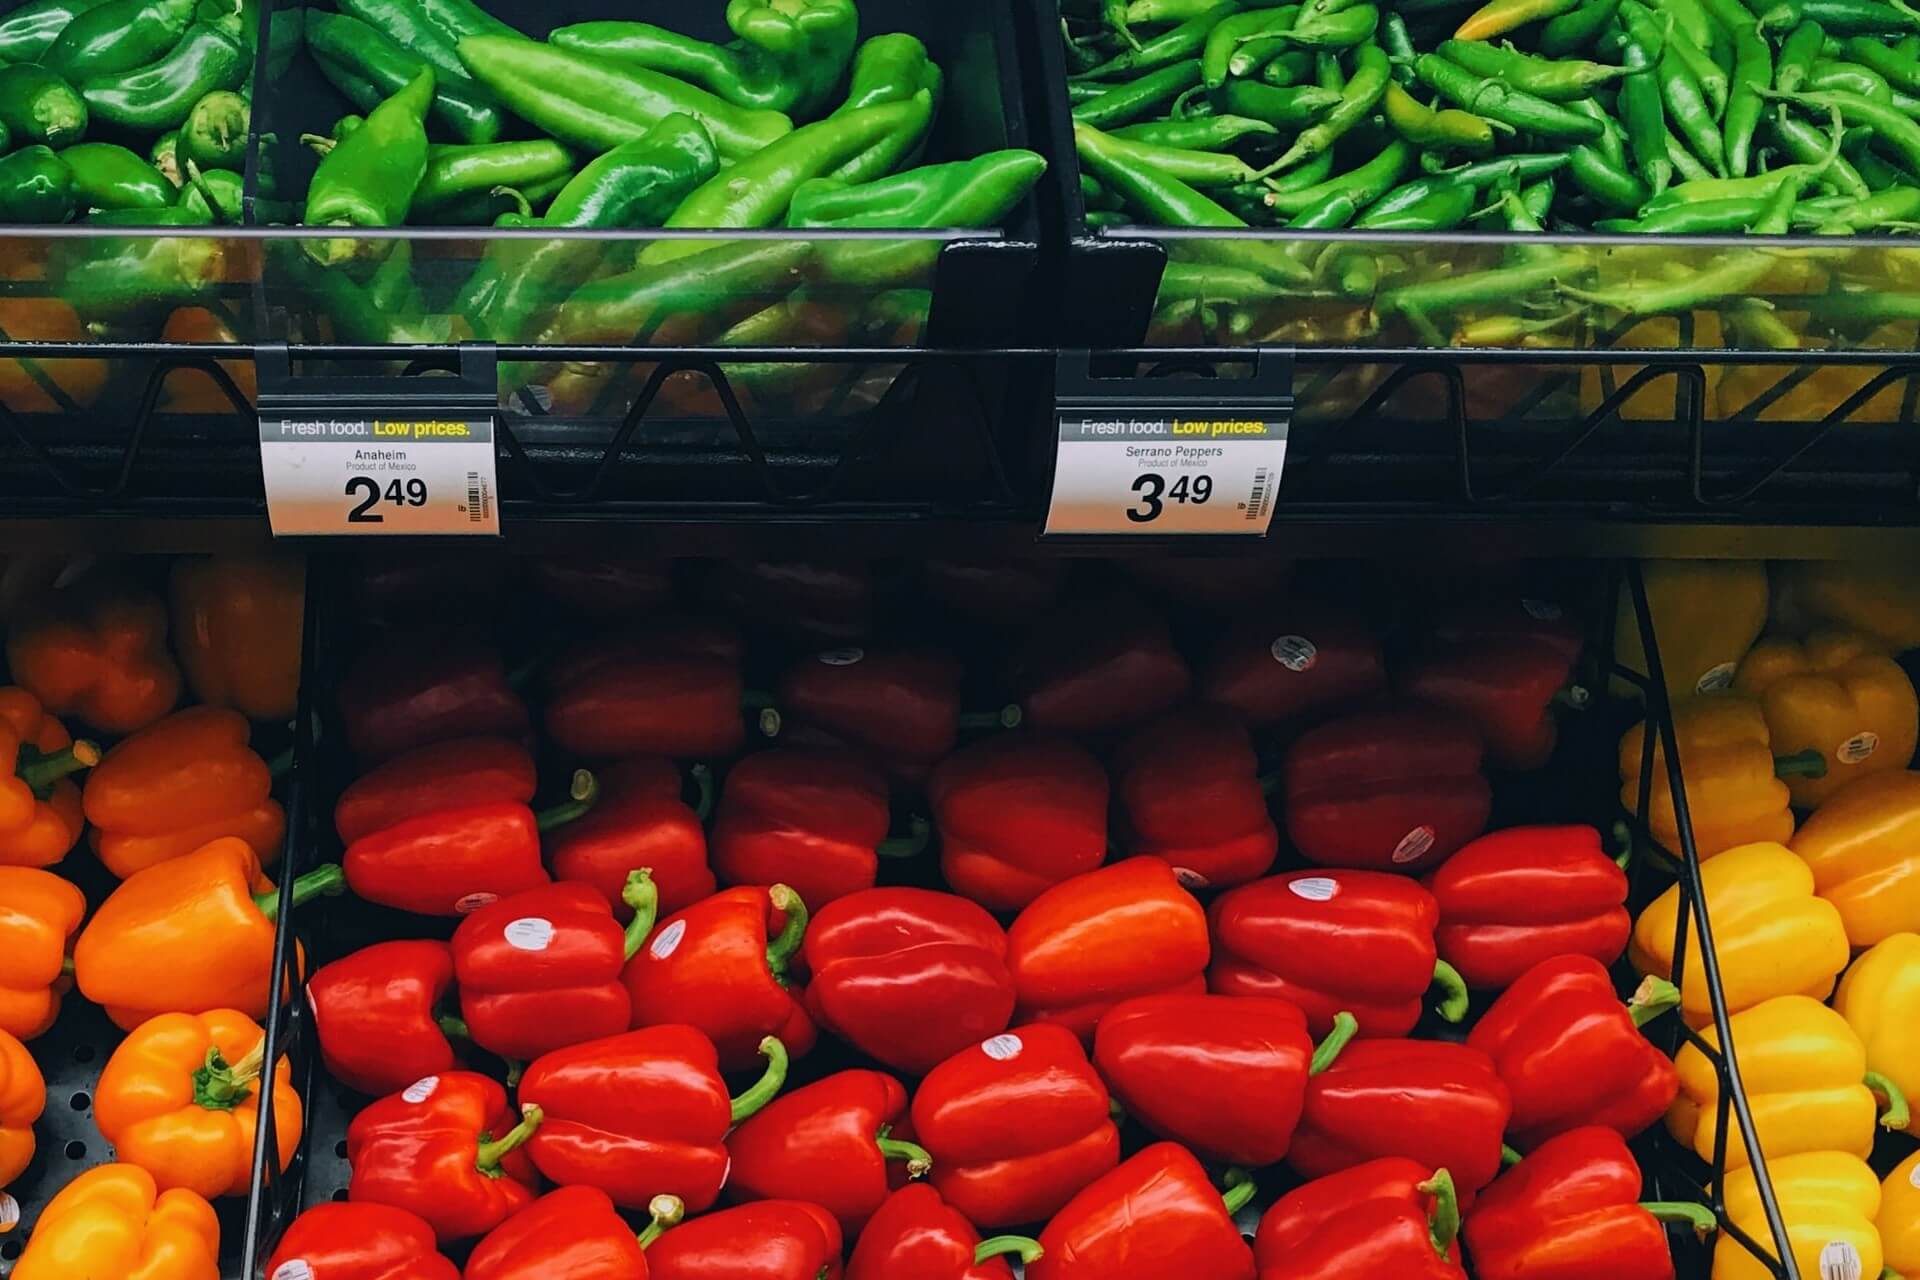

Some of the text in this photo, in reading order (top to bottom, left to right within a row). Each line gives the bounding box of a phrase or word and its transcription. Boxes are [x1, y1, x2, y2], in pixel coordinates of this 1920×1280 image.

[281, 420, 471, 438] Fresh food. Low prices.
[1081, 419, 1268, 437] Fresh food. Low prices.
[354, 450, 407, 461] Anaheim
[1126, 446, 1223, 459] Serrano Peppers
[346, 462, 417, 471] Product of Mexico
[1138, 458, 1208, 468] Product of Mexico
